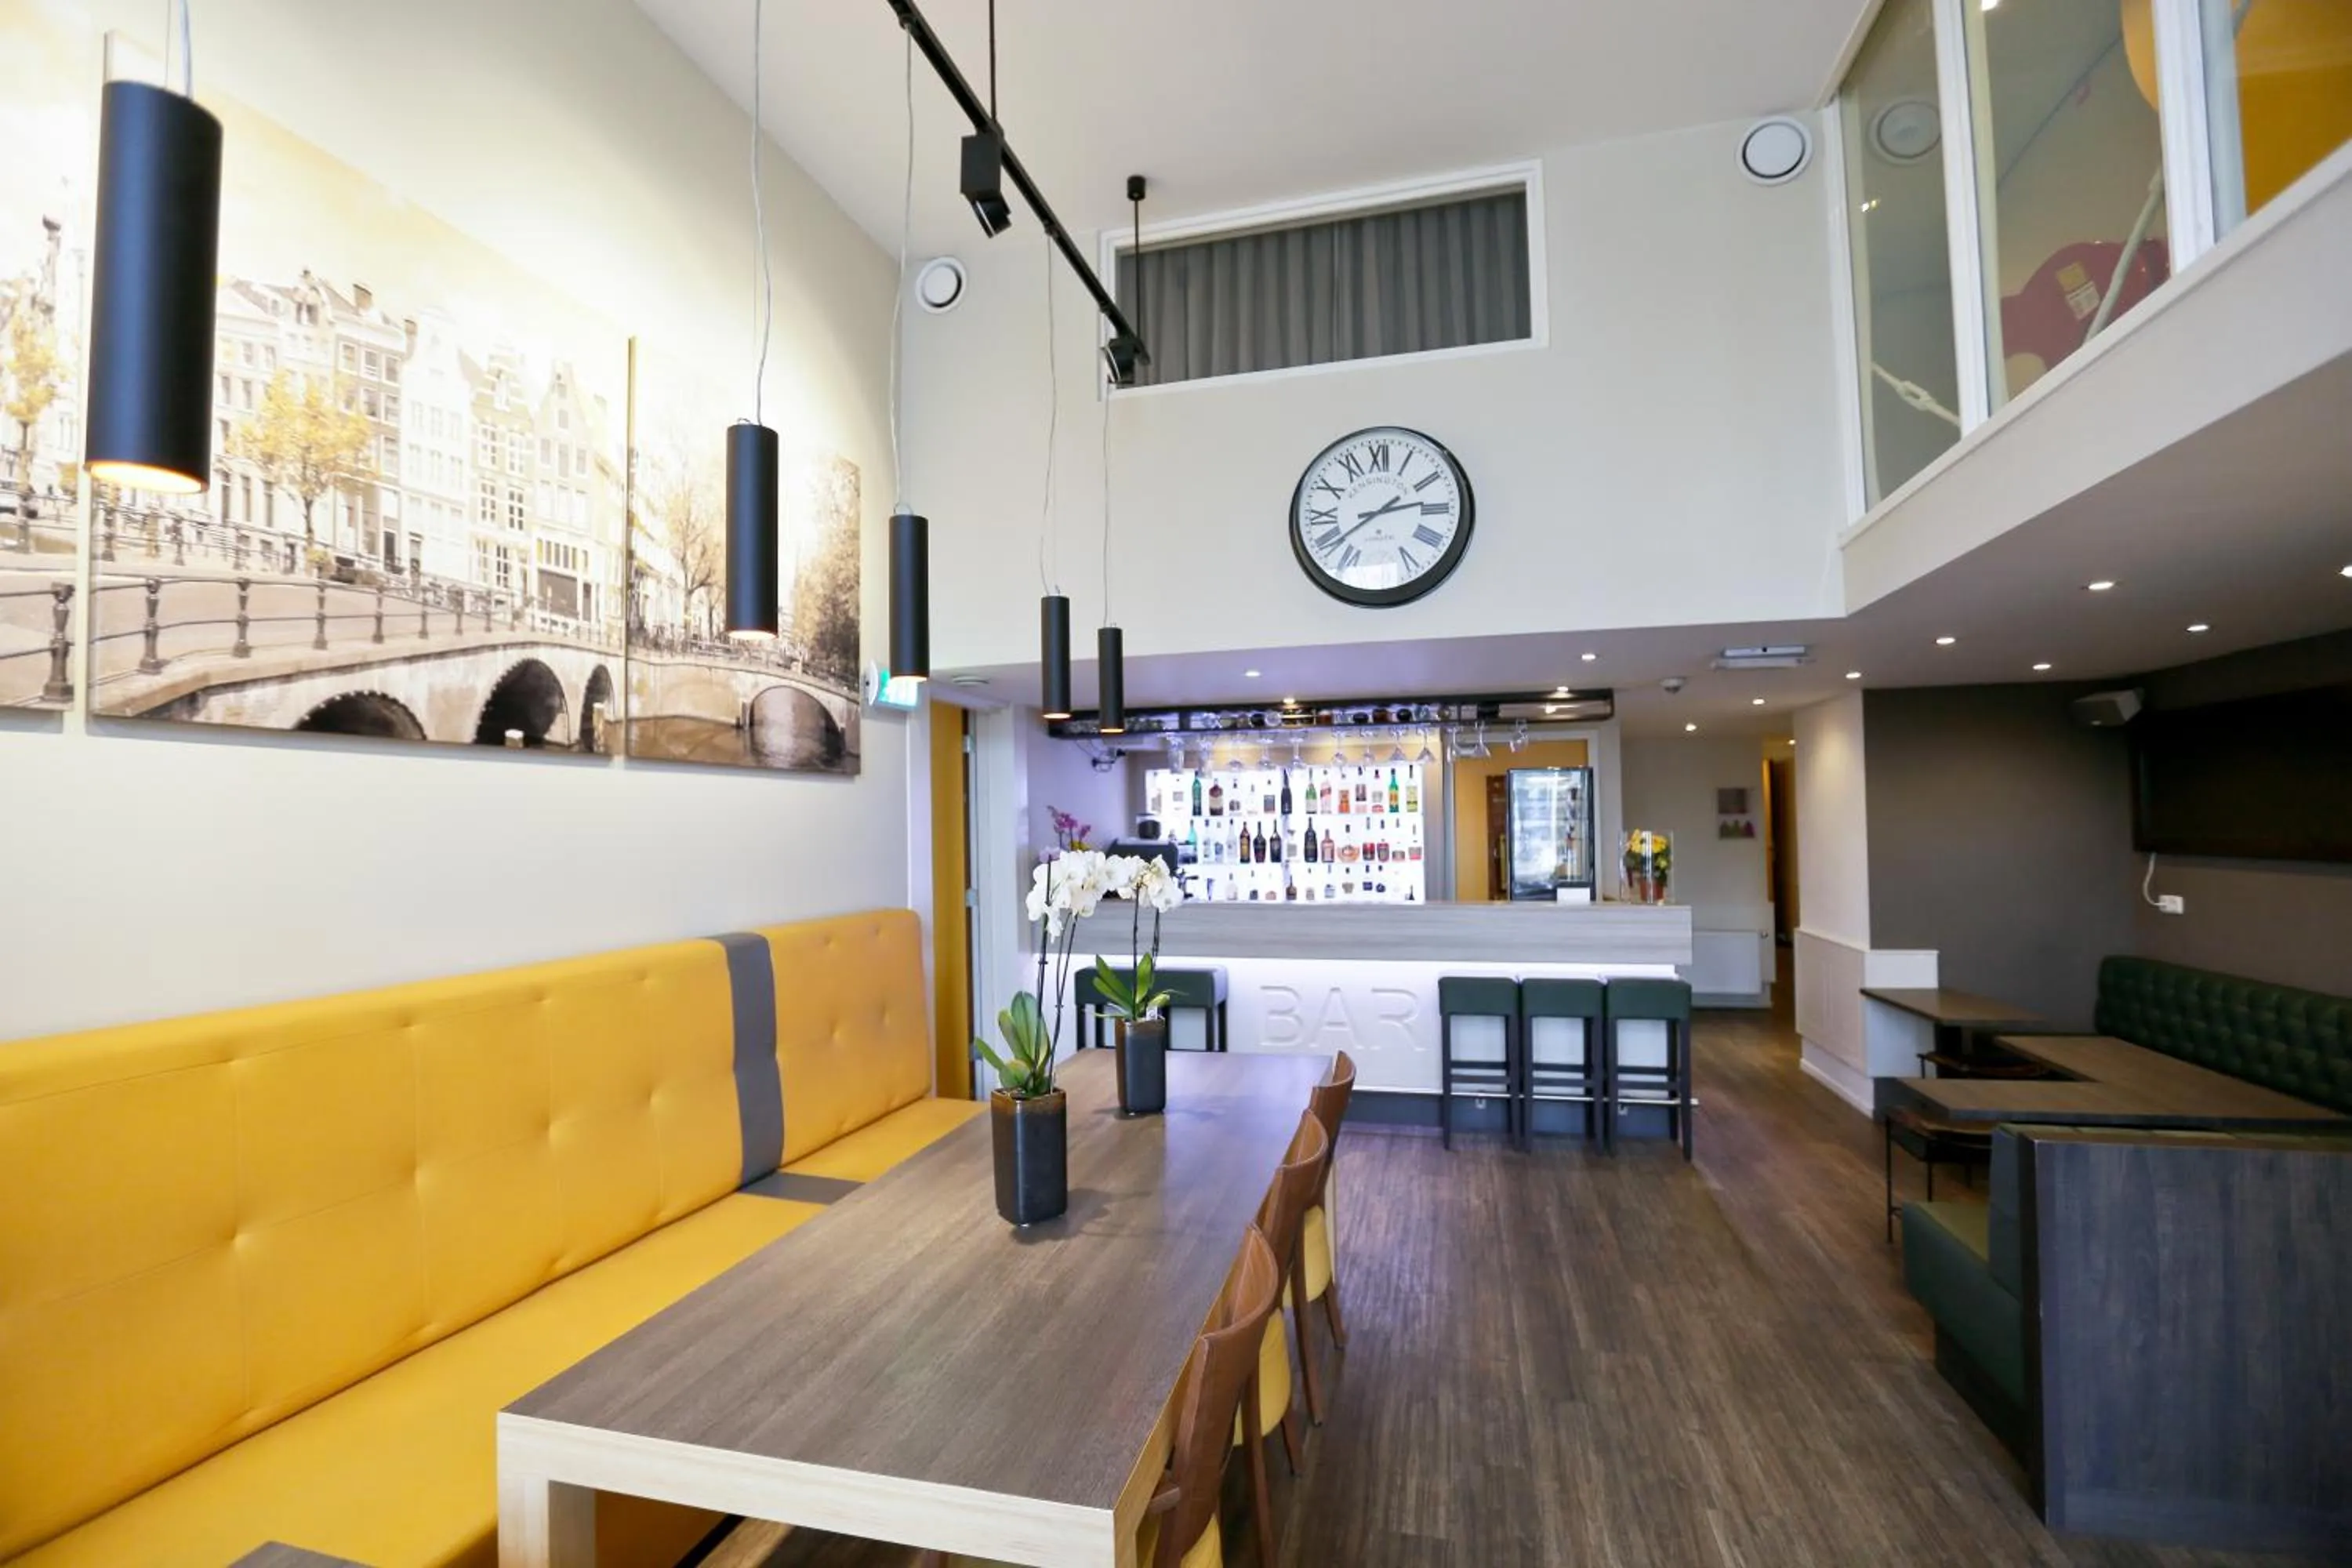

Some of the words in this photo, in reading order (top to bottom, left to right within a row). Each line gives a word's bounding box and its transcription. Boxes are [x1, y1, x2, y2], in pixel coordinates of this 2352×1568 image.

[1338, 452, 1365, 484] XI
[1368, 445, 1389, 474] XII
[1316, 477, 1345, 500] X
[1414, 470, 1440, 492] II
[1310, 507, 1338, 525] IX
[1420, 503, 1450, 515] III
[1399, 546, 1420, 572] V
[1259, 985, 1427, 1051] BAR
